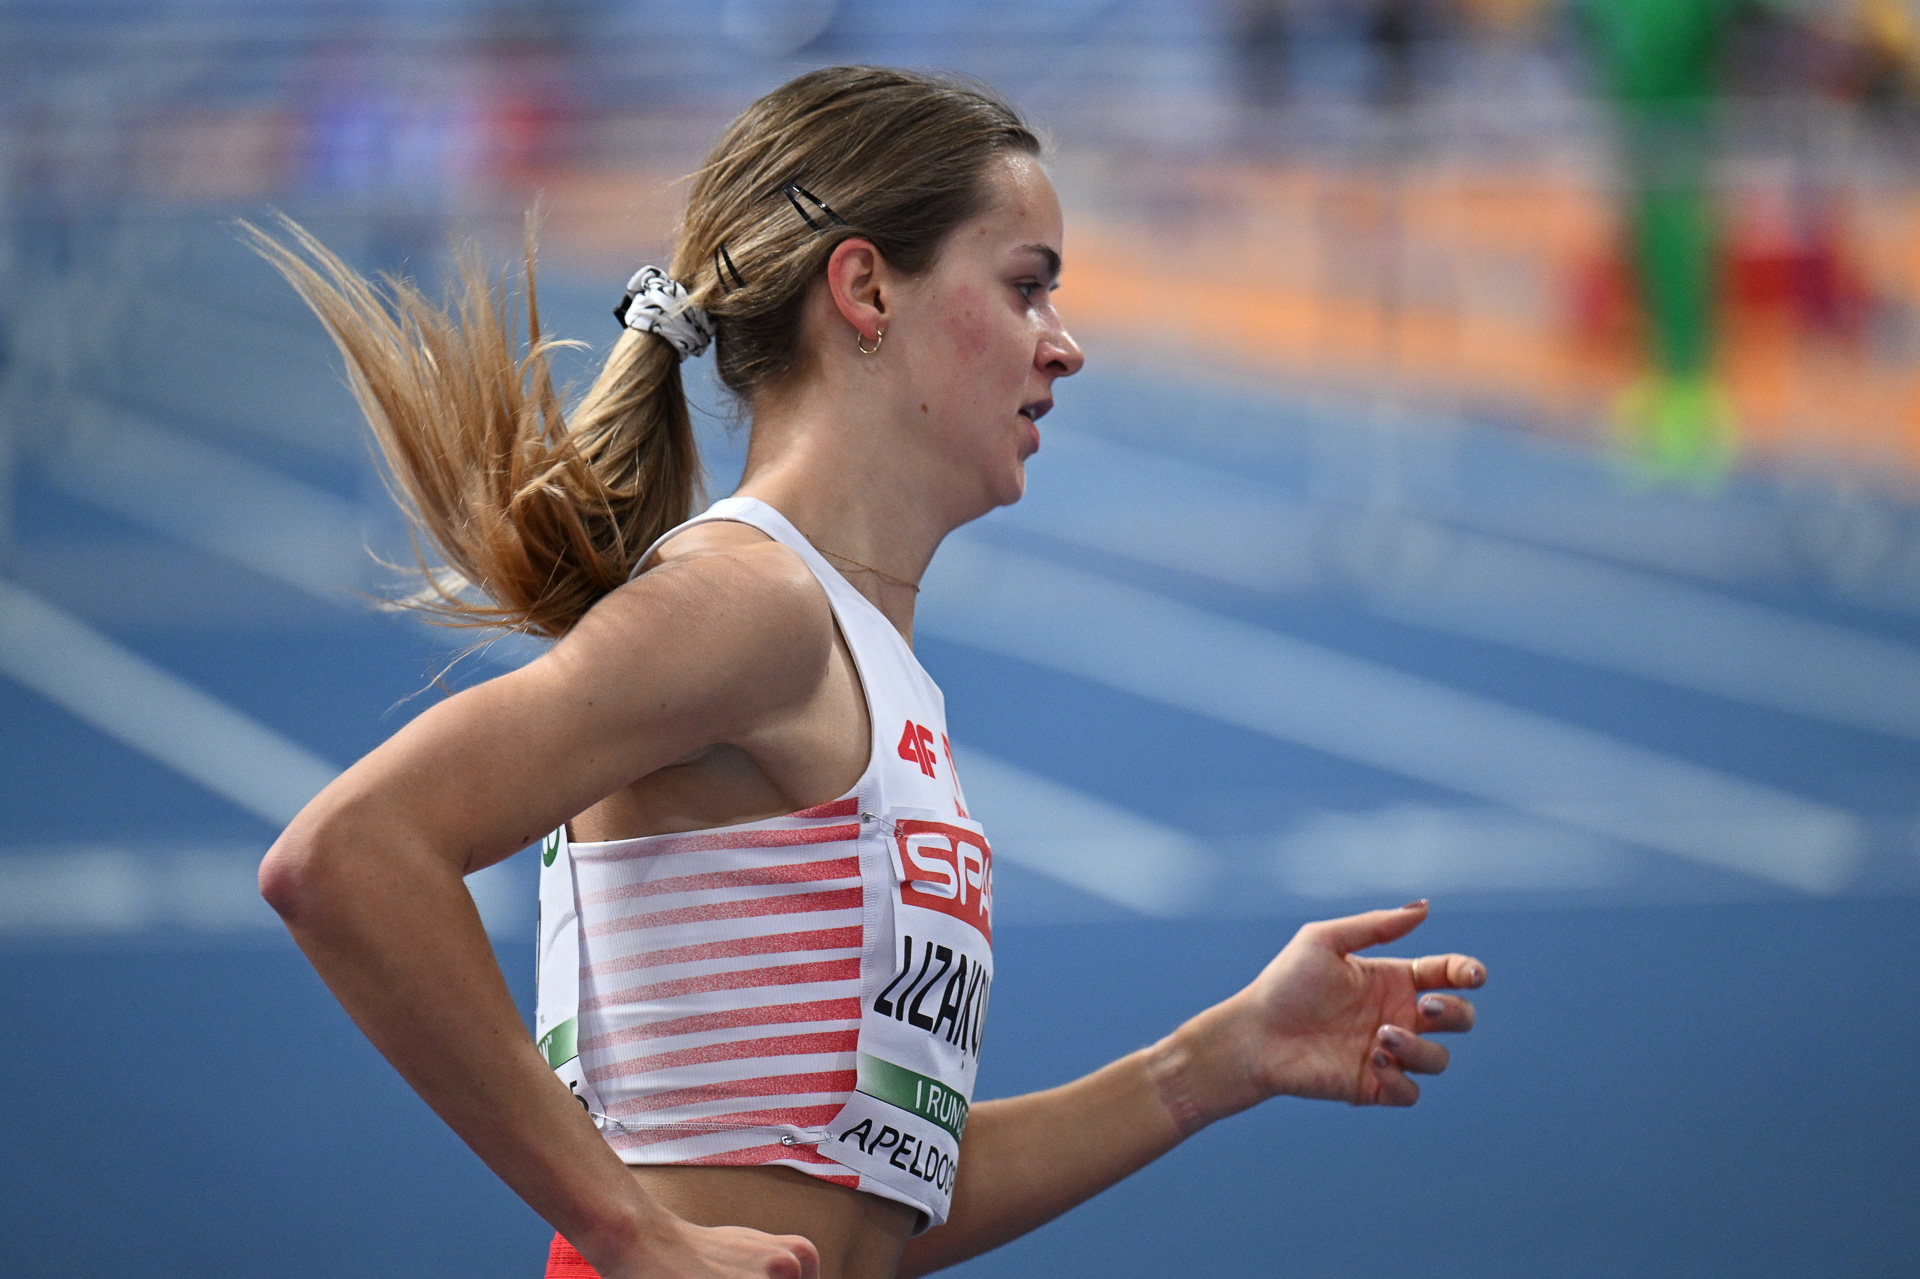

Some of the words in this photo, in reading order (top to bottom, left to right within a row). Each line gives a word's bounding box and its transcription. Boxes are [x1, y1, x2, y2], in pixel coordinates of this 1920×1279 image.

[898, 719, 936, 779] 4F
[906, 834, 992, 927] SPA
[873, 934, 989, 1065] LIZAKO
[915, 1080, 923, 1110] I
[838, 1118, 956, 1196] APELDOO
